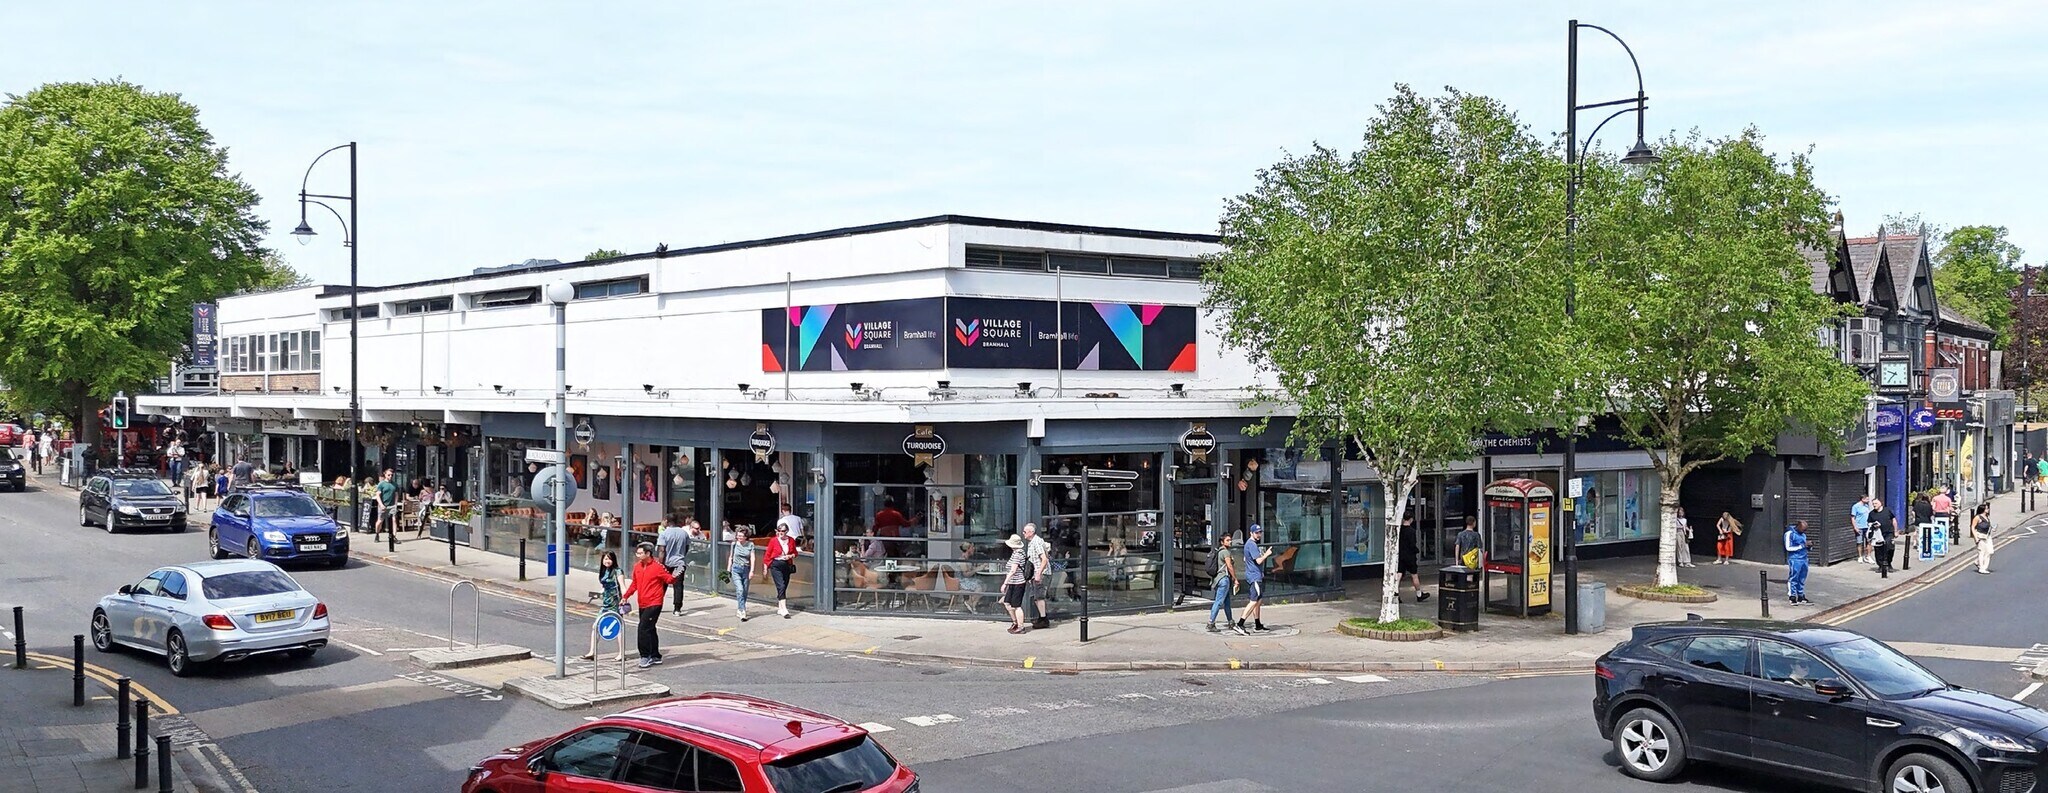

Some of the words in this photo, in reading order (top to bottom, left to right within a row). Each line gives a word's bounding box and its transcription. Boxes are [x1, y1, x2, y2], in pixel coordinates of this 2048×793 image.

[863, 321, 892, 330] VILLAGE
[982, 319, 1022, 329] VILLAGE
[863, 331, 892, 341] SQUARE
[903, 330, 927, 340] Bramhall
[927, 330, 937, 339] life
[982, 329, 1022, 339] SQUARE
[906, 442, 942, 450] TURQUOISE
[1185, 438, 1213, 447] TURQUOISE
[1484, 439, 1497, 447] THE
[1498, 437, 1531, 447] CHEMISTS
[1531, 582, 1547, 594] £3.75
